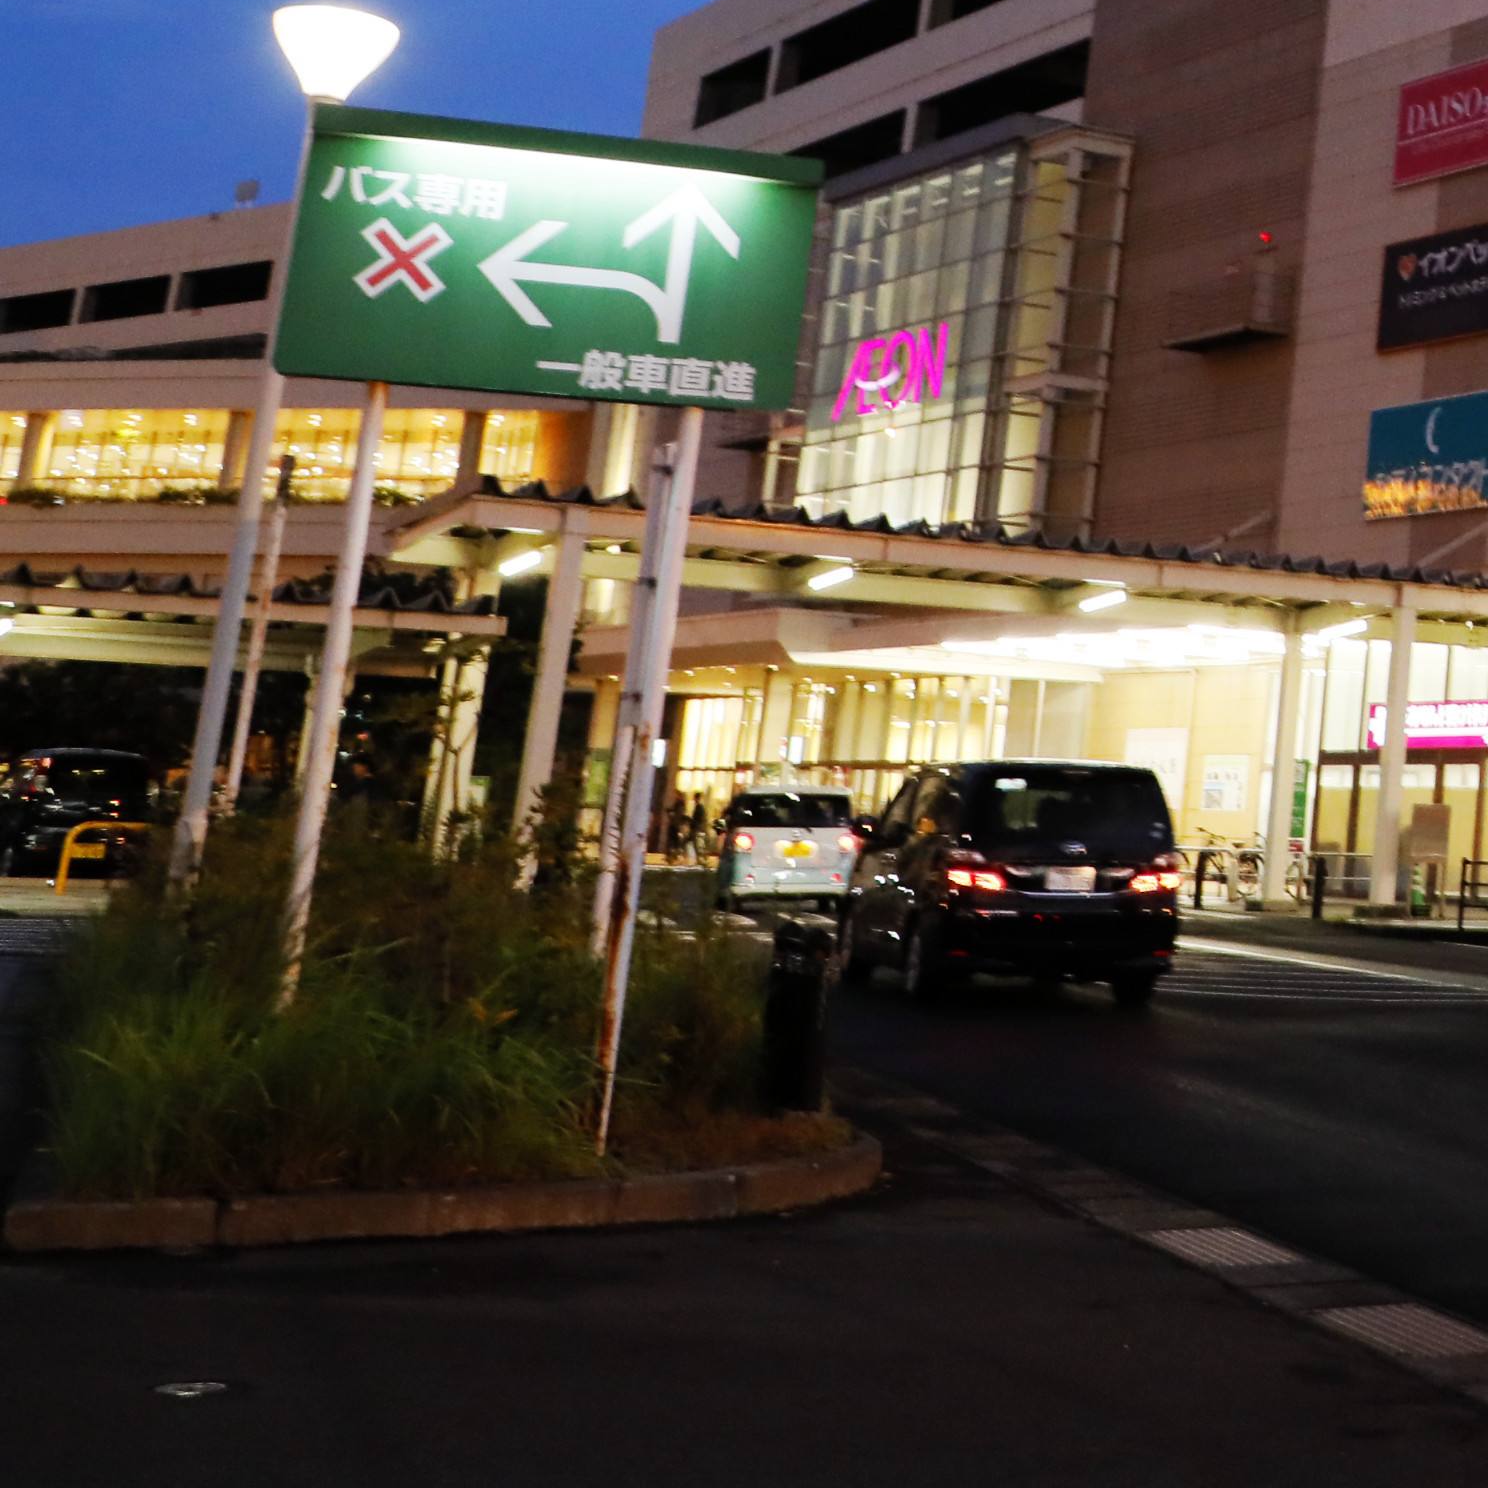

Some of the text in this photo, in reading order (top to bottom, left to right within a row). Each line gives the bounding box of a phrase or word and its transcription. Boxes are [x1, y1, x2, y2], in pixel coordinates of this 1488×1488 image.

[1406, 86, 1482, 135] DAISO
[321, 165, 508, 220] バス専用
[535, 349, 756, 402] 一般車直進
